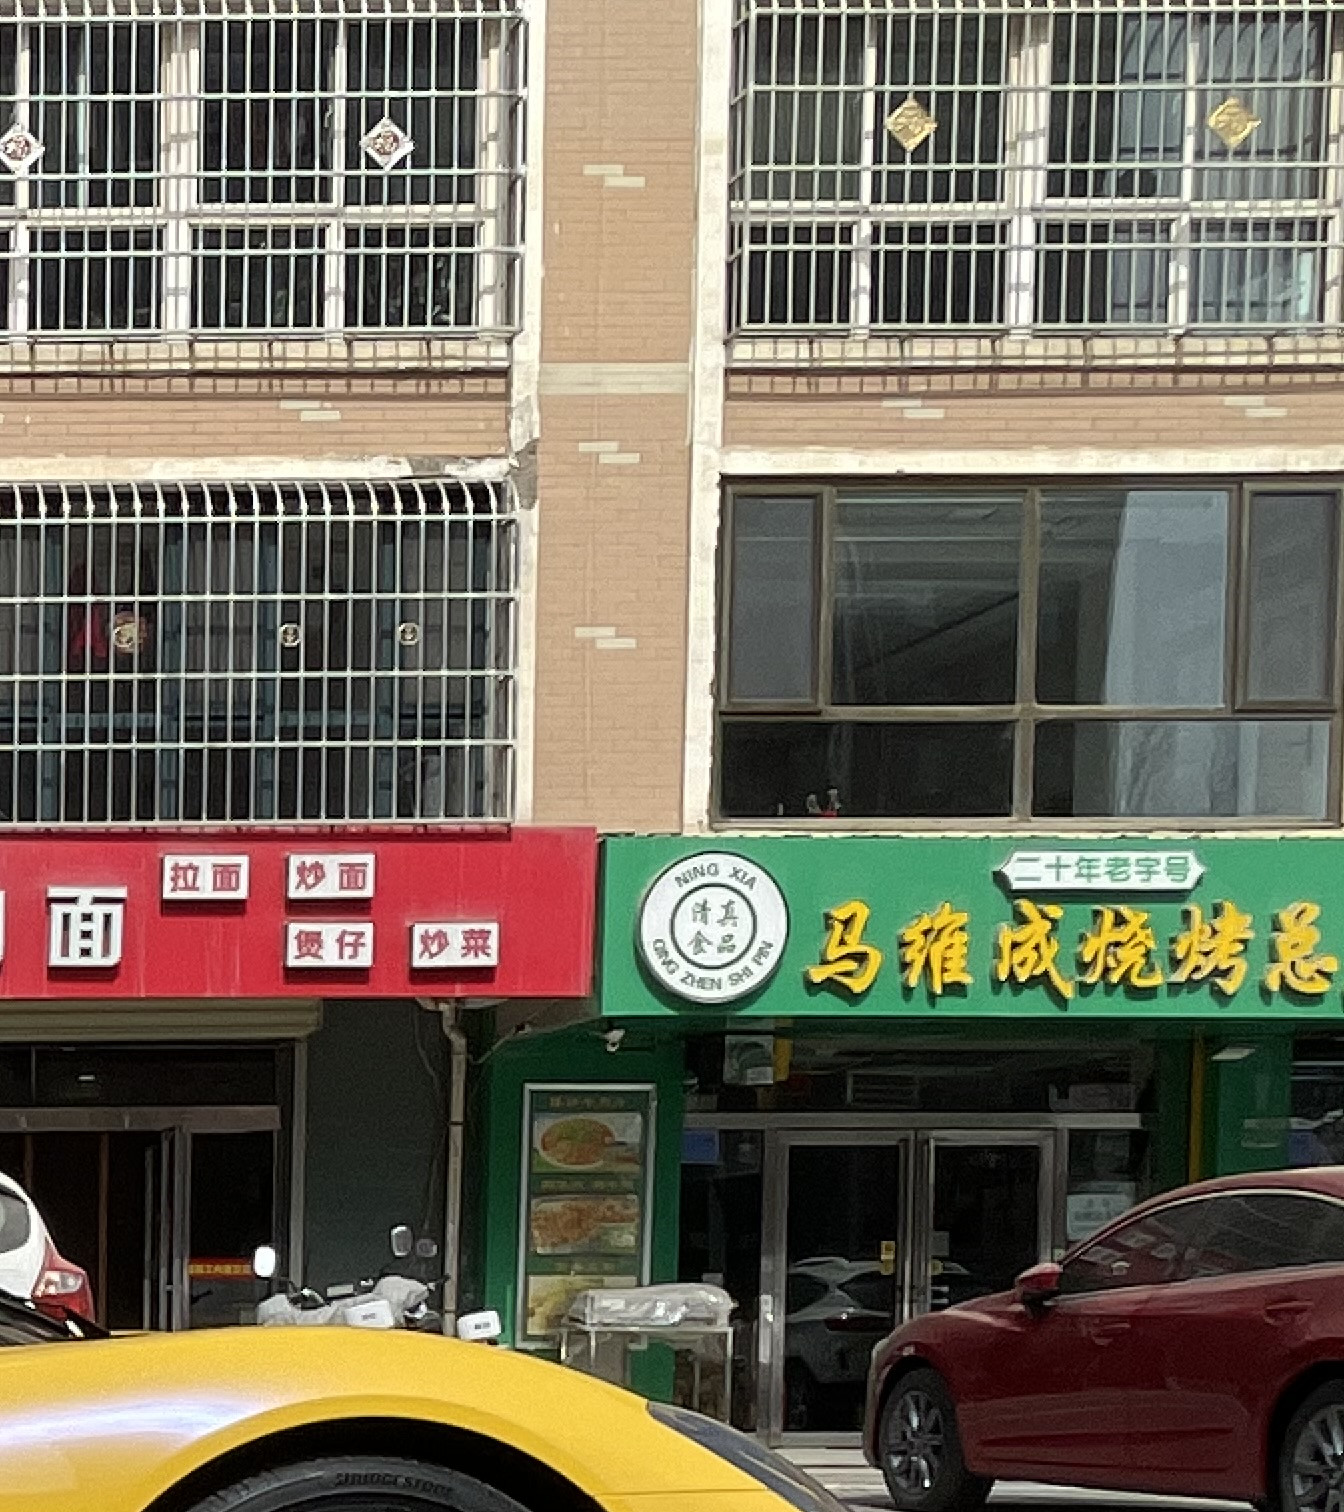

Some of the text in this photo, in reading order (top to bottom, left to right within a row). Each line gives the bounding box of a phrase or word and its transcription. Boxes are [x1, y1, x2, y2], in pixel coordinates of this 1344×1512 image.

[171, 862, 242, 892] 拉面
[295, 861, 369, 890] 炒面
[674, 863, 757, 890] NING XIA
[1015, 856, 1191, 883] 二十年老字号
[294, 930, 366, 960] 煲仔
[419, 929, 492, 958] 炒菜
